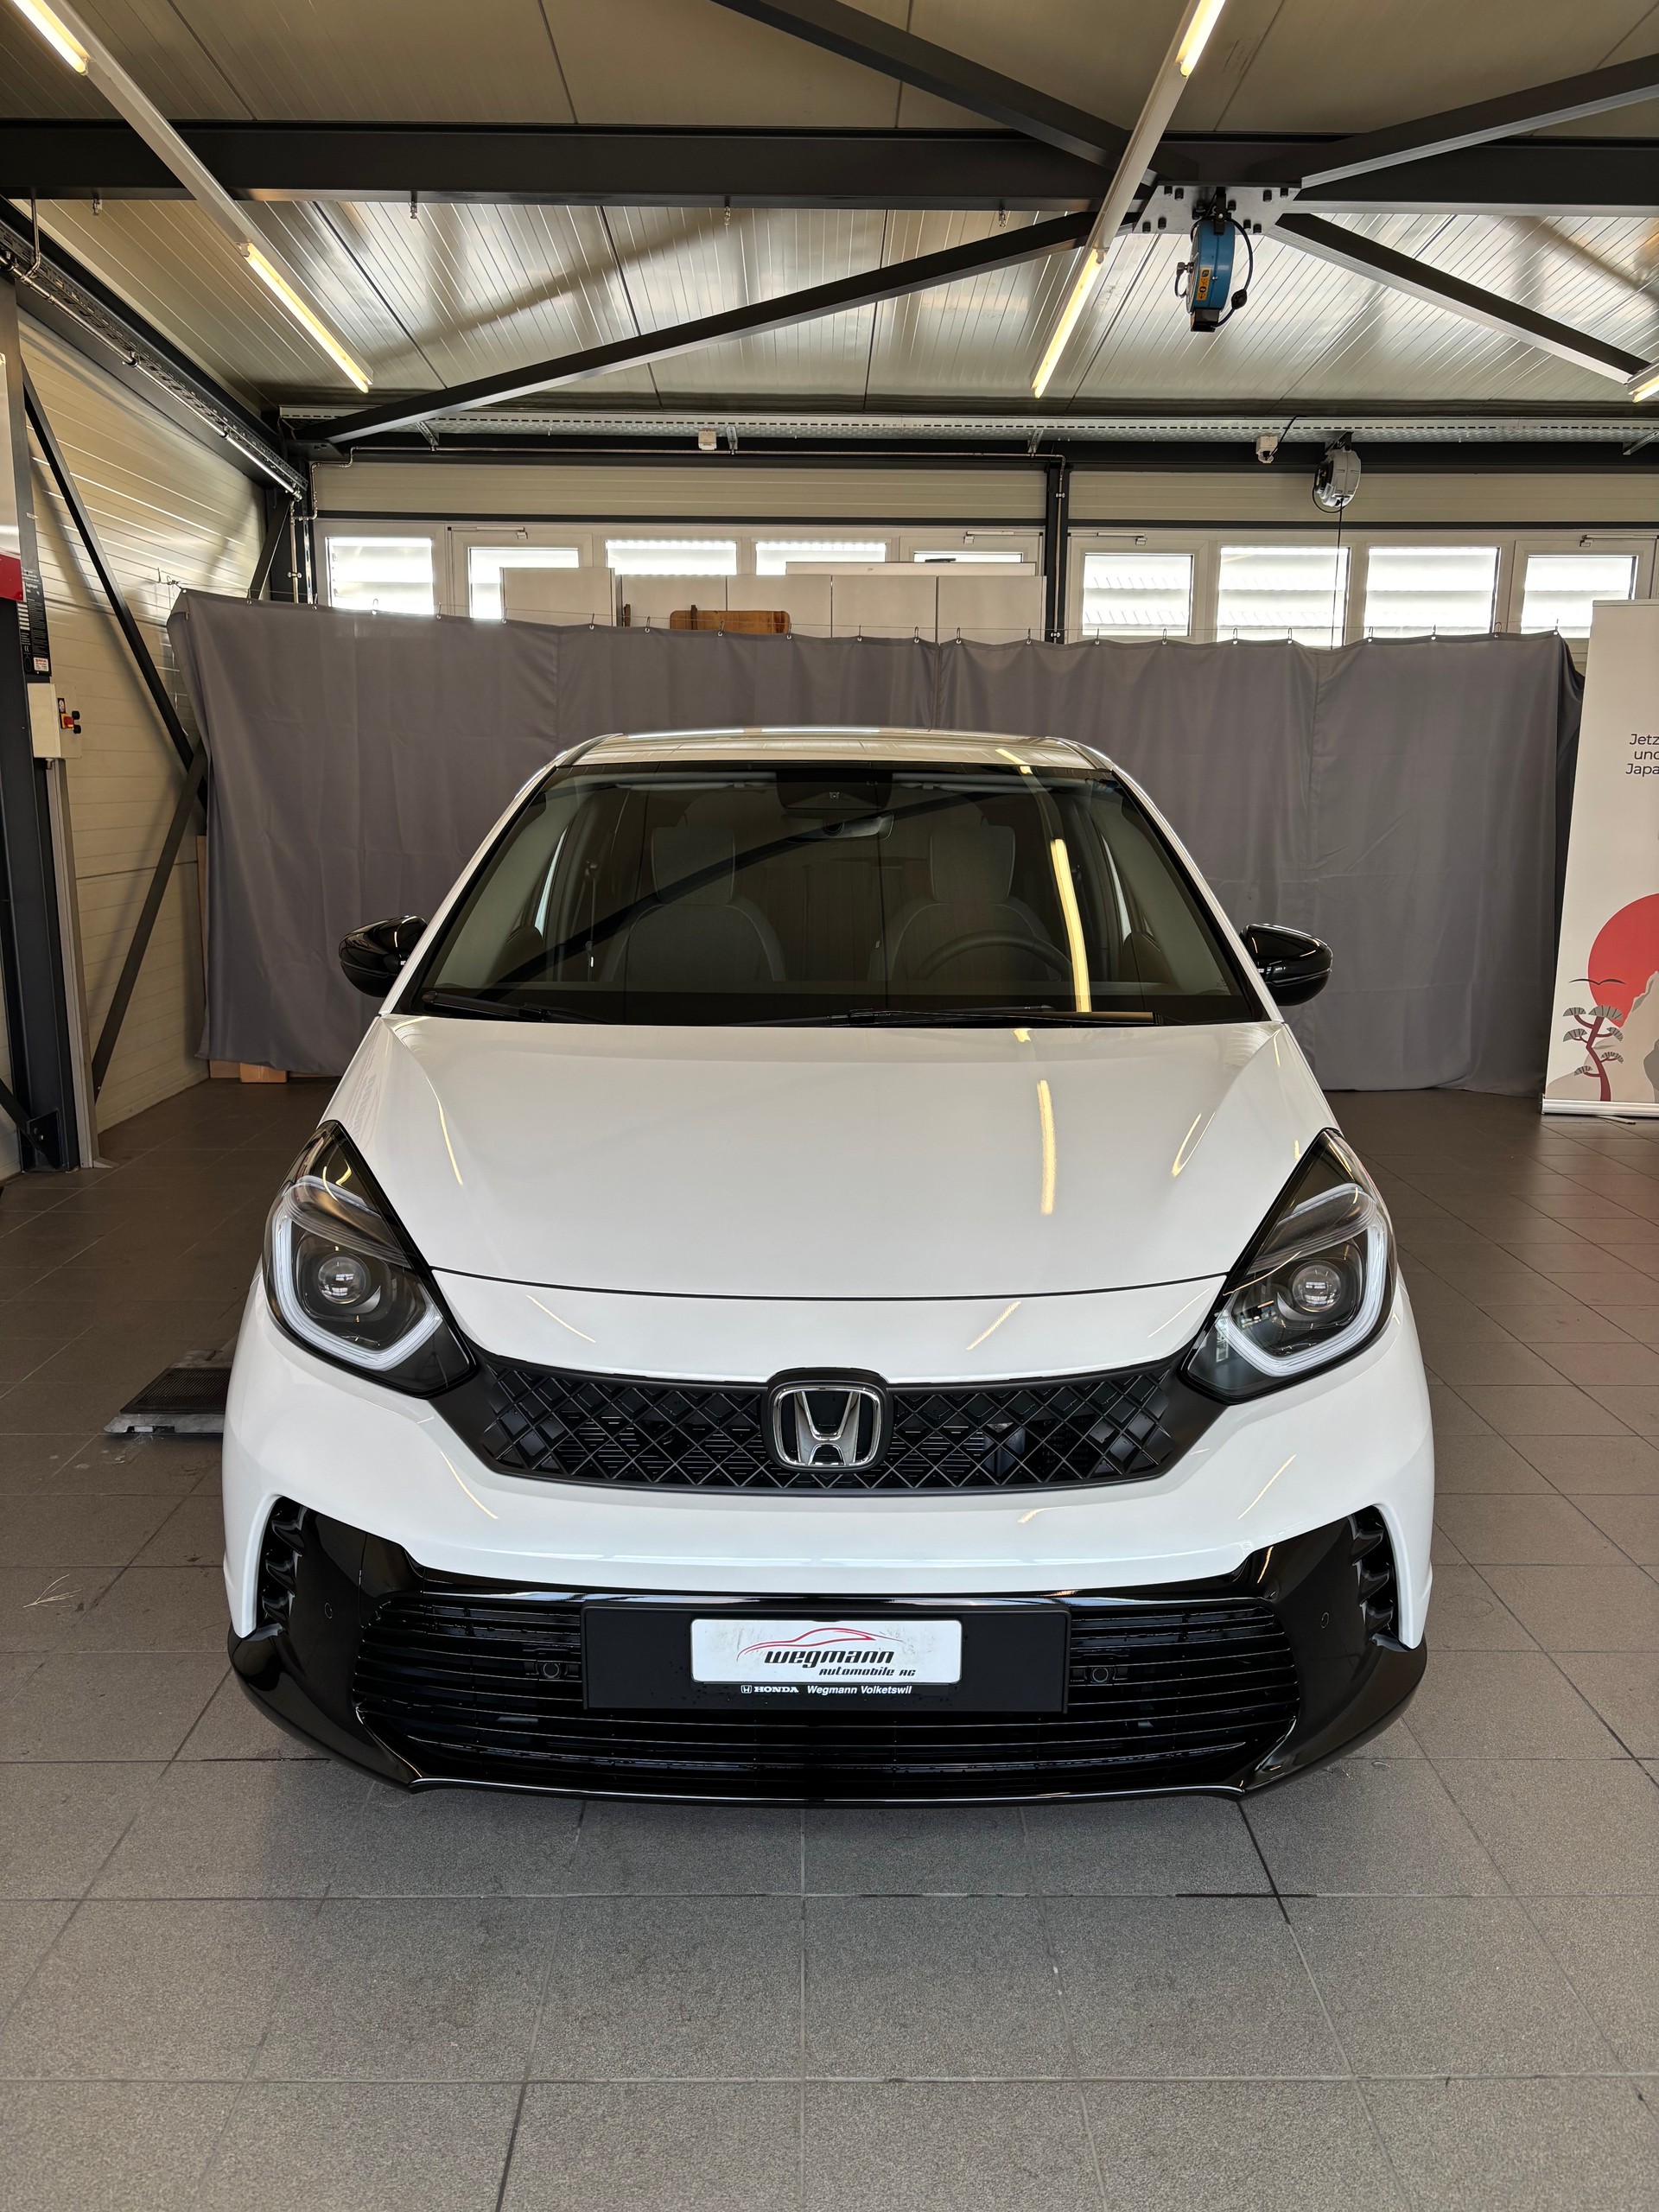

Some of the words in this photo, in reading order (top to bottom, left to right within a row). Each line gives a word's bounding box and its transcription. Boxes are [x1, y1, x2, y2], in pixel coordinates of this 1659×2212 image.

[1625, 763, 1659, 777] Japa
[807, 1685, 858, 1695] Wegmann
[861, 1685, 912, 1694] Volketswil
